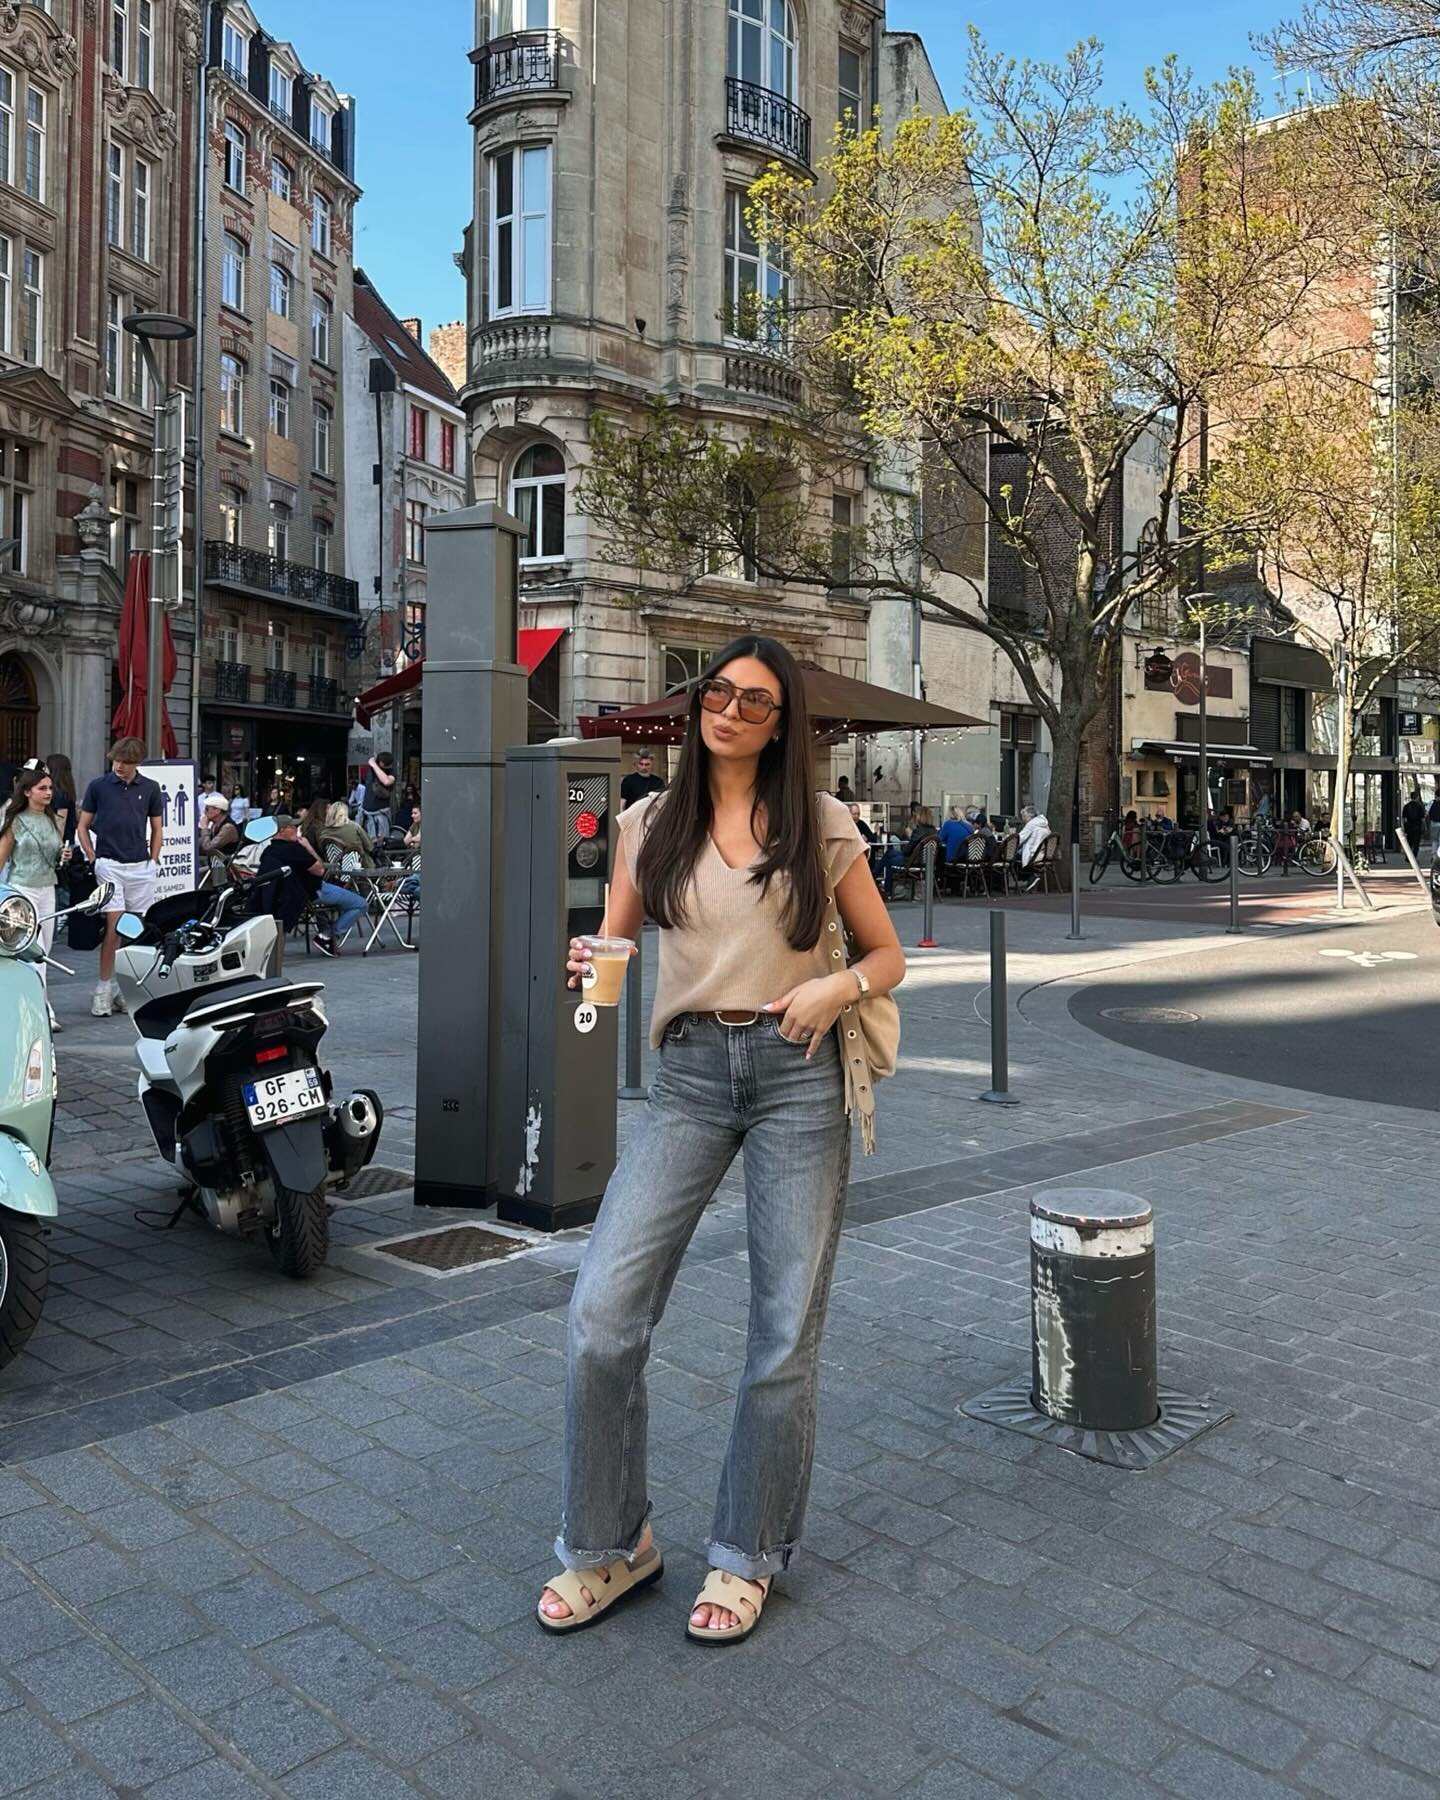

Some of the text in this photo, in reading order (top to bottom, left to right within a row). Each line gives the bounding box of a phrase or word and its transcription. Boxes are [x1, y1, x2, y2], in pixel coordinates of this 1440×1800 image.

[569, 789, 584, 802] 20
[162, 836, 192, 847] ETONNE
[163, 853, 192, 866] TERRE
[579, 1012, 592, 1024] 20
[255, 1089, 321, 1121] 926-CM
